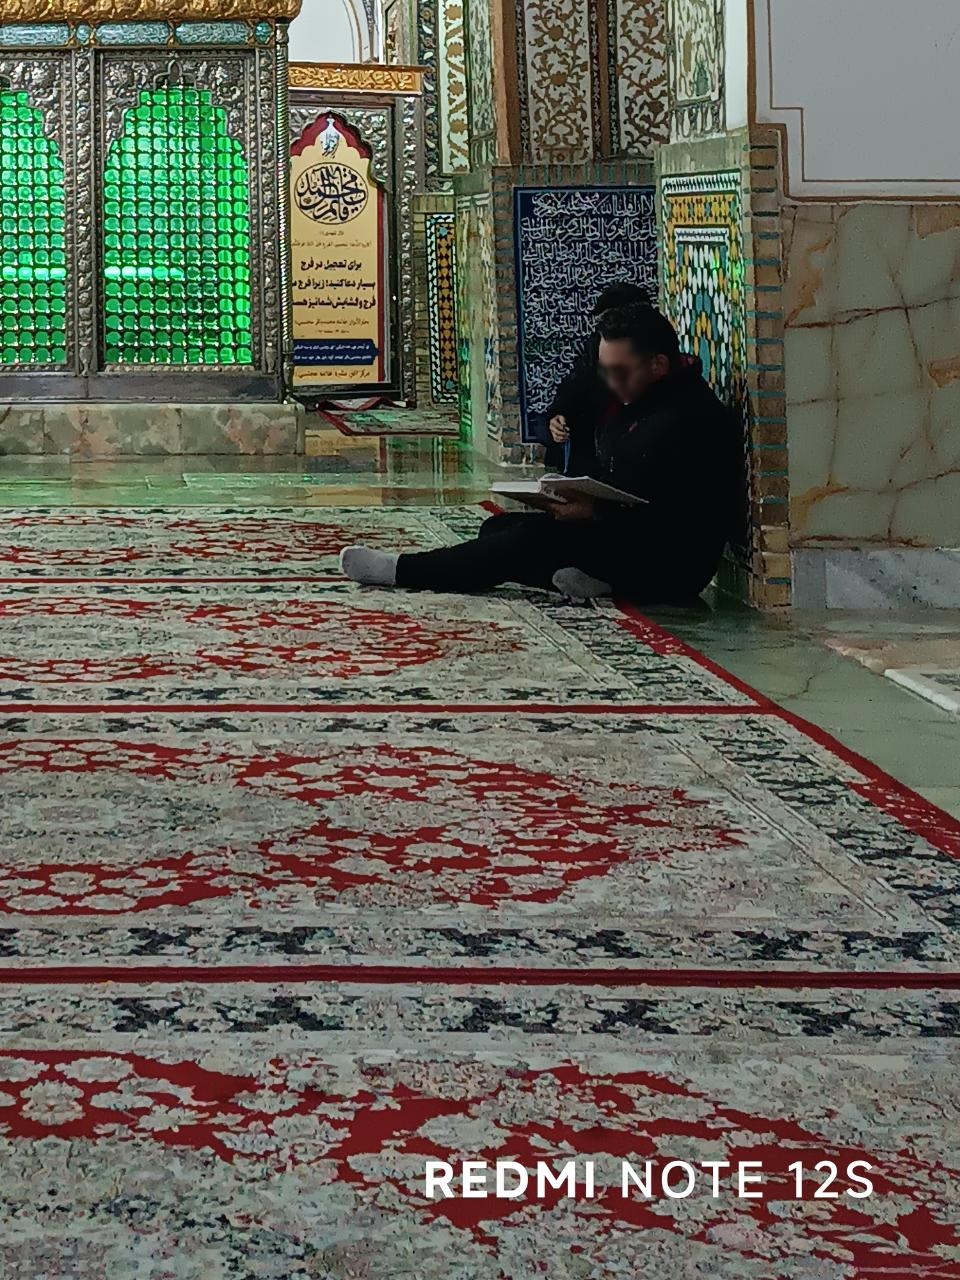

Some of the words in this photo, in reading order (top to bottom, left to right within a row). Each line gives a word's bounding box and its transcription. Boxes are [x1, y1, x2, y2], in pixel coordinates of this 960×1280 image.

[301, 257, 314, 271] فرج
[315, 261, 322, 270] در
[324, 260, 346, 270] تعجیل
[348, 259, 361, 270] برای
[298, 276, 311, 289] فرج
[357, 279, 375, 290] بسیار
[363, 296, 376, 309] فرج
